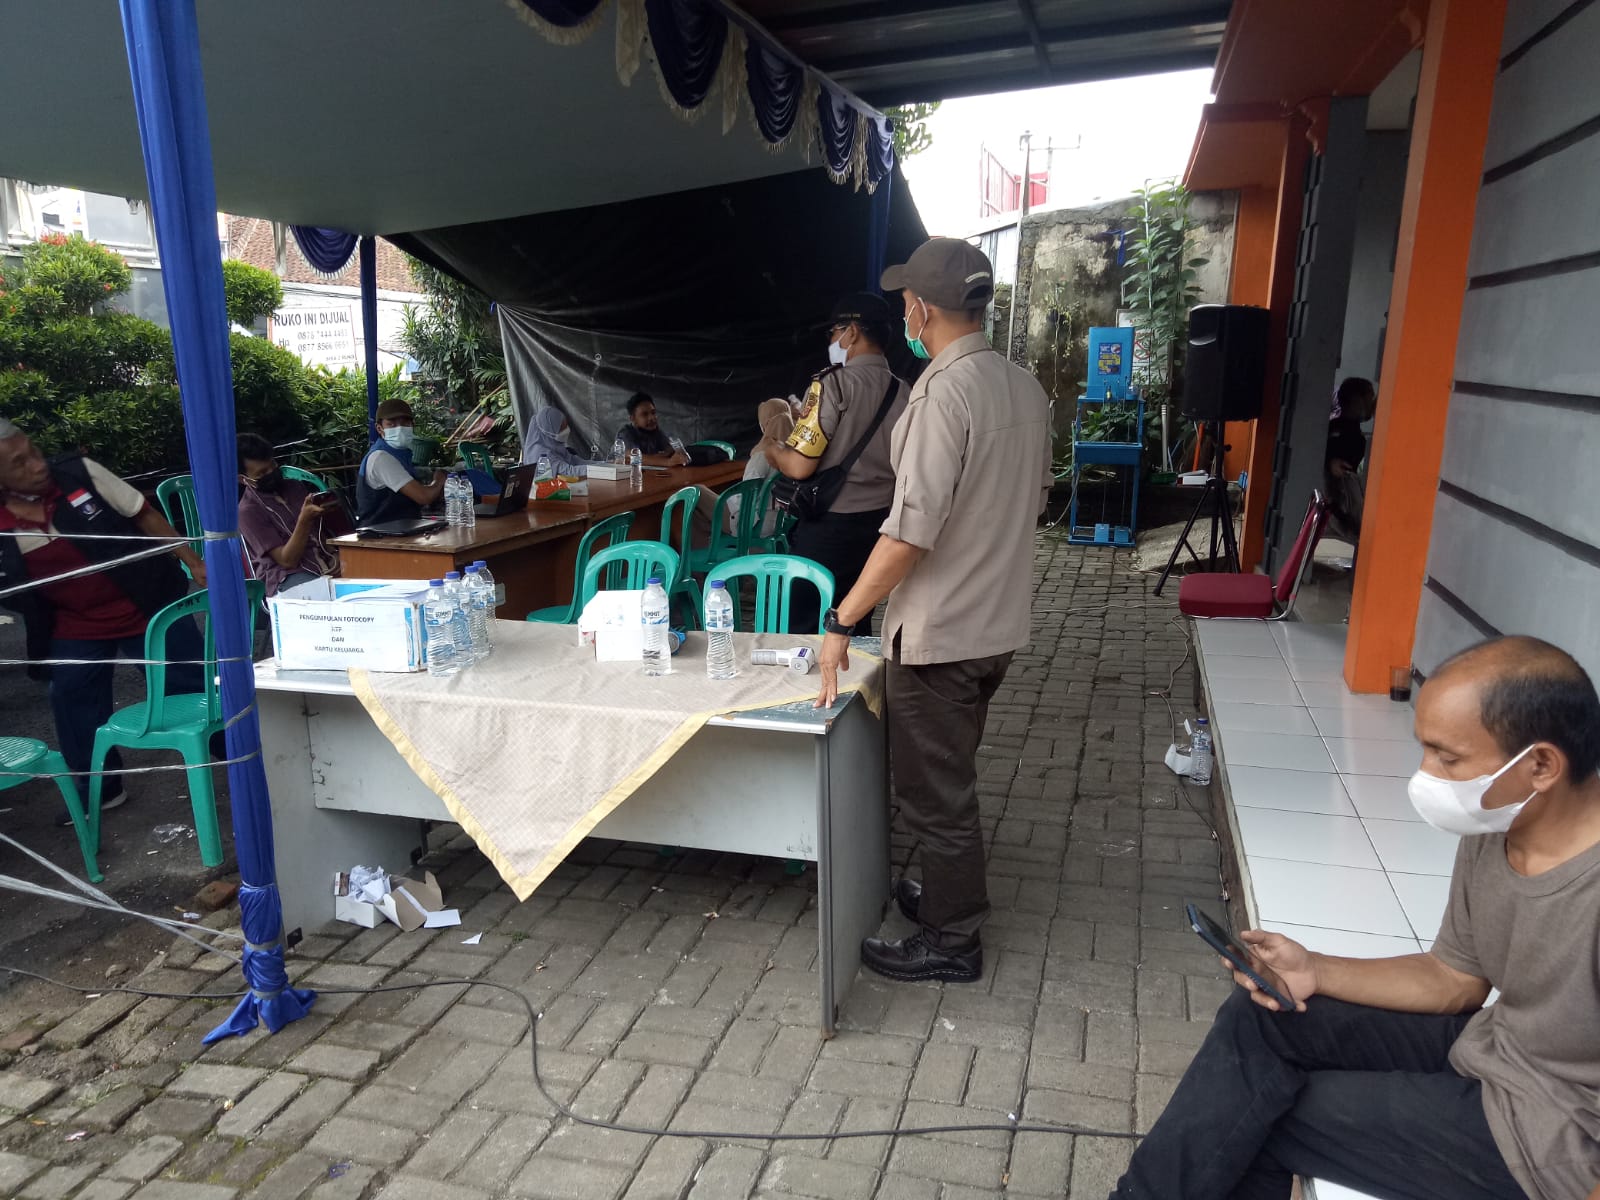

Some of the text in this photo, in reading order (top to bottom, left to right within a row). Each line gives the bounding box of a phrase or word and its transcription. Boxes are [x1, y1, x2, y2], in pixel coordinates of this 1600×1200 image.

[274, 311, 349, 326] RUKO INI DIJUAL
[299, 614, 343, 622] PENGUMPULAN
